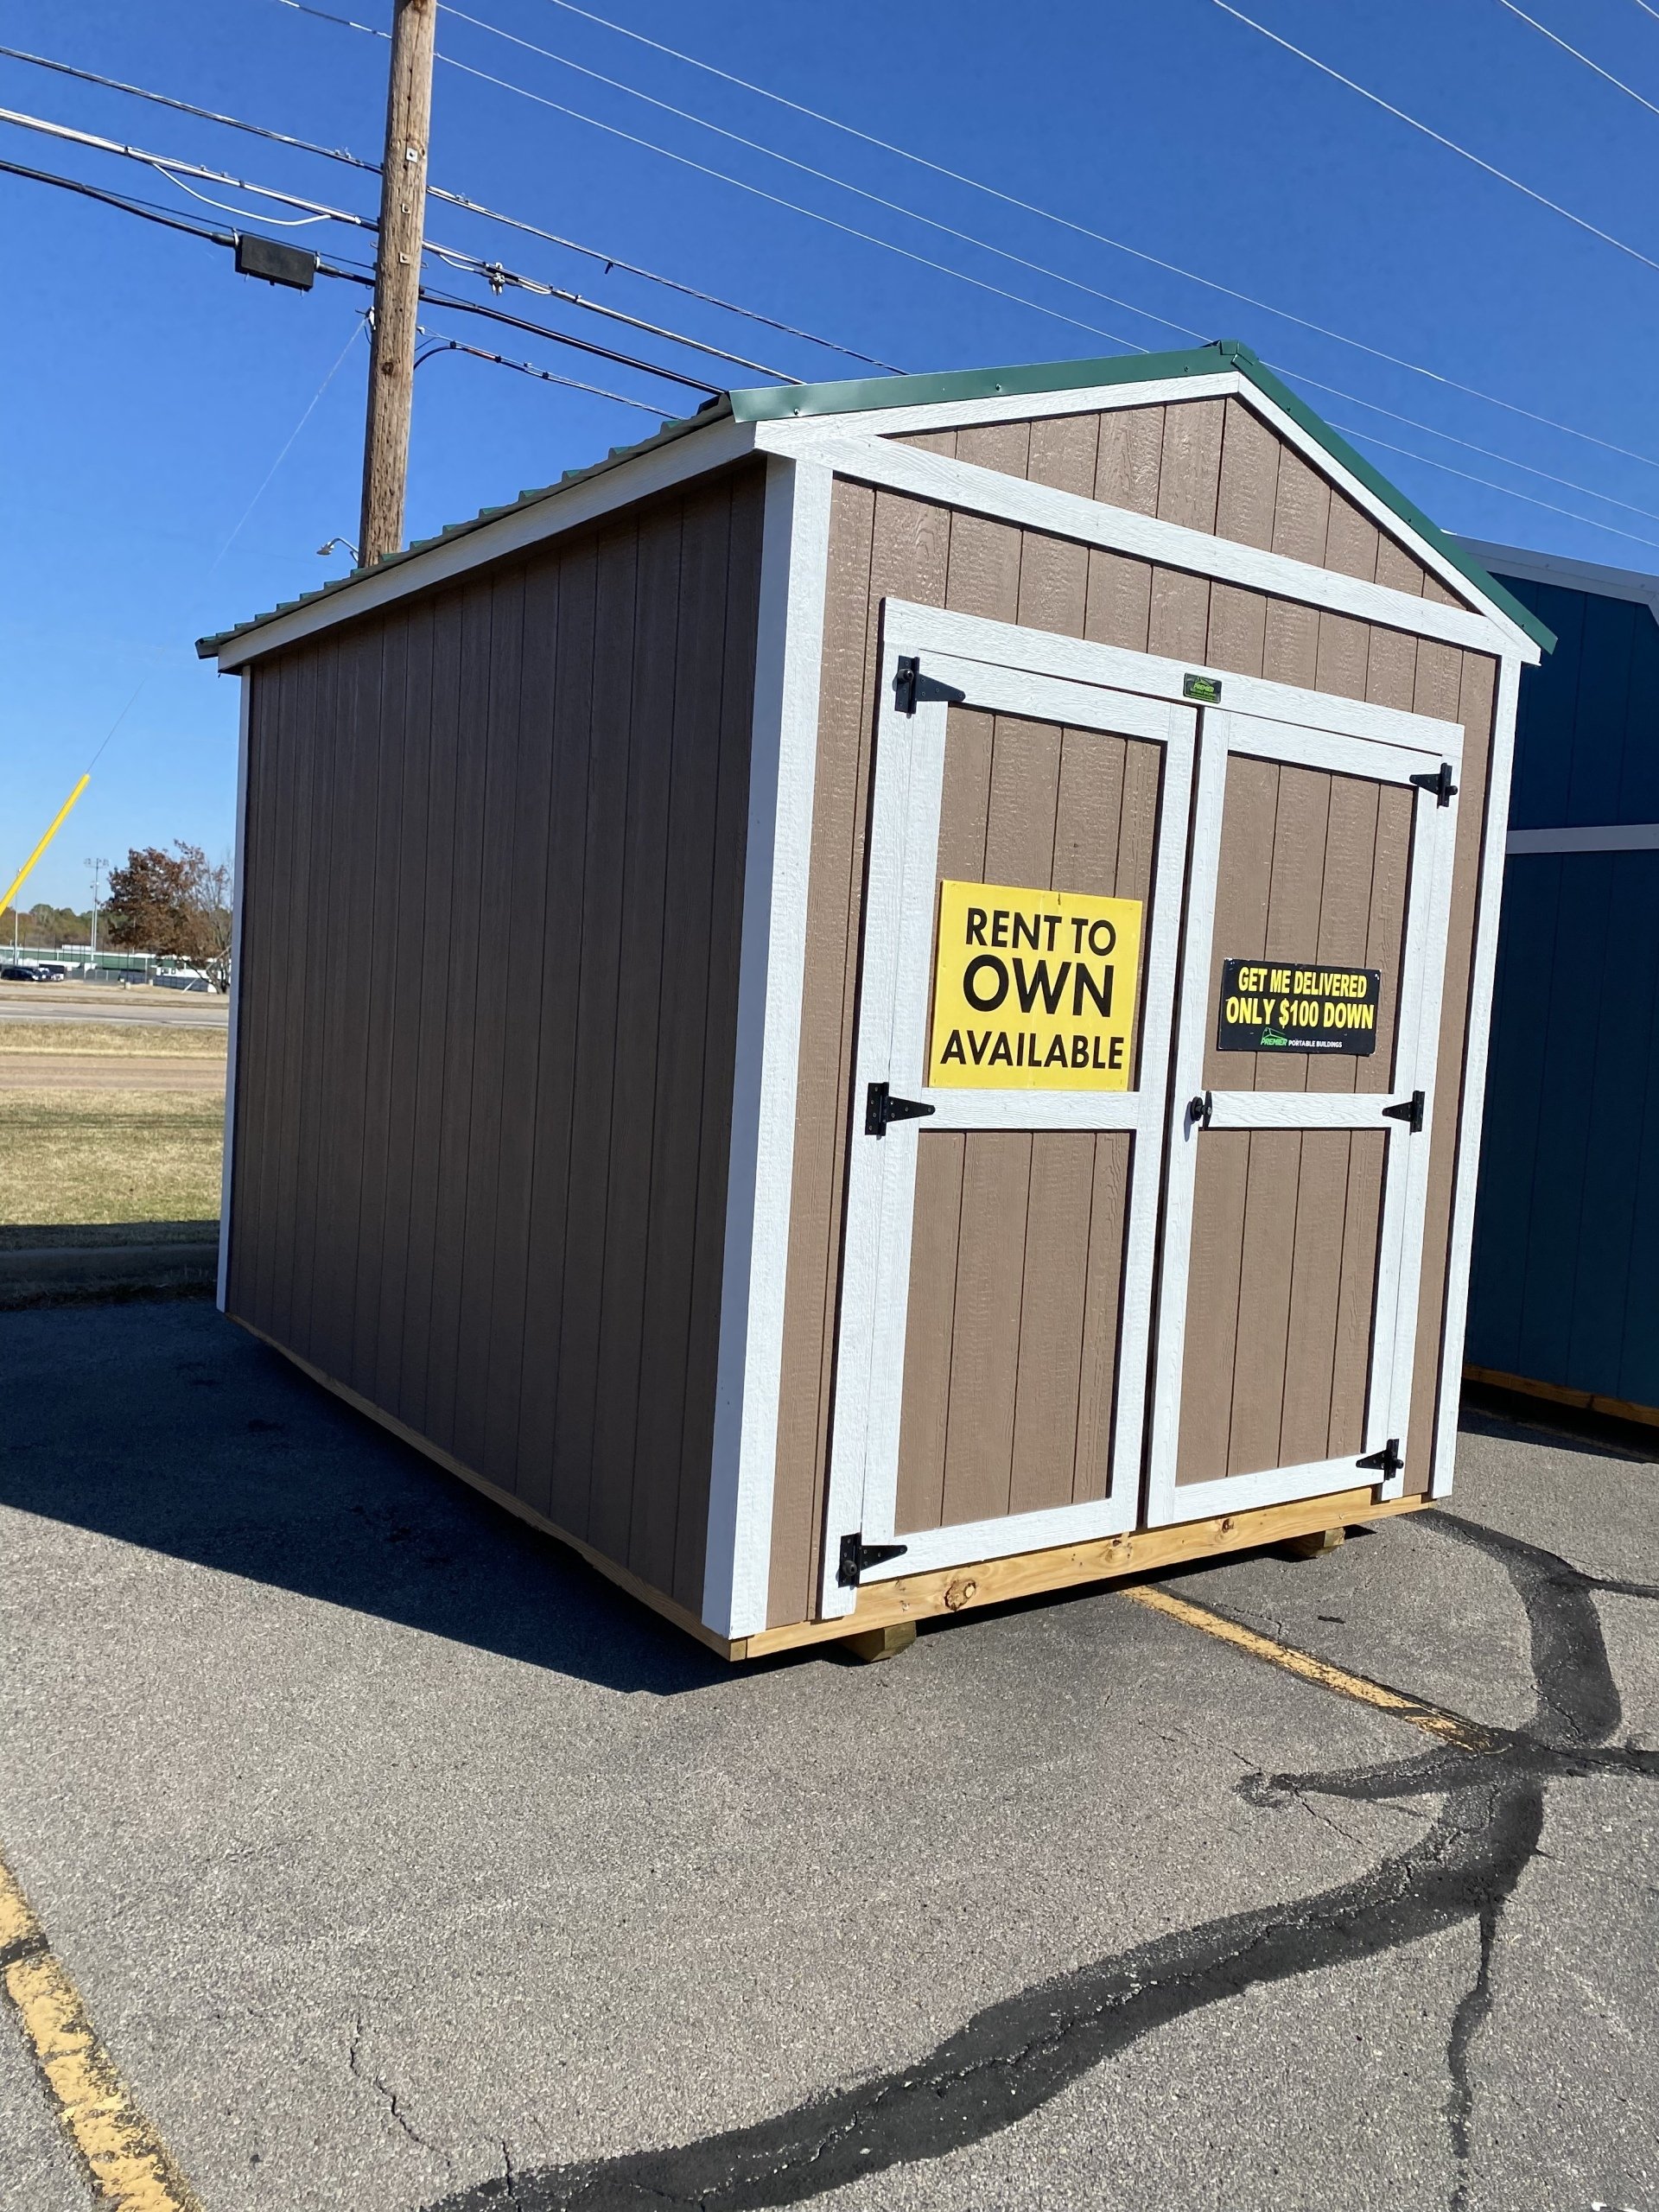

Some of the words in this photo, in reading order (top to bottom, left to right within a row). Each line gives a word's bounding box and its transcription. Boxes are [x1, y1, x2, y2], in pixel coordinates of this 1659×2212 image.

[966, 907, 1062, 951] RENT
[1071, 918, 1116, 956] TO
[963, 954, 1114, 1017] OWN
[1238, 967, 1268, 991] GET
[1269, 969, 1291, 994] ME
[1294, 970, 1368, 998] DELIVERED
[1226, 996, 1275, 1025] ONLY
[1279, 998, 1319, 1029] $100
[1324, 1002, 1374, 1029] DOWN
[940, 1029, 1124, 1070] AVAILABLE
